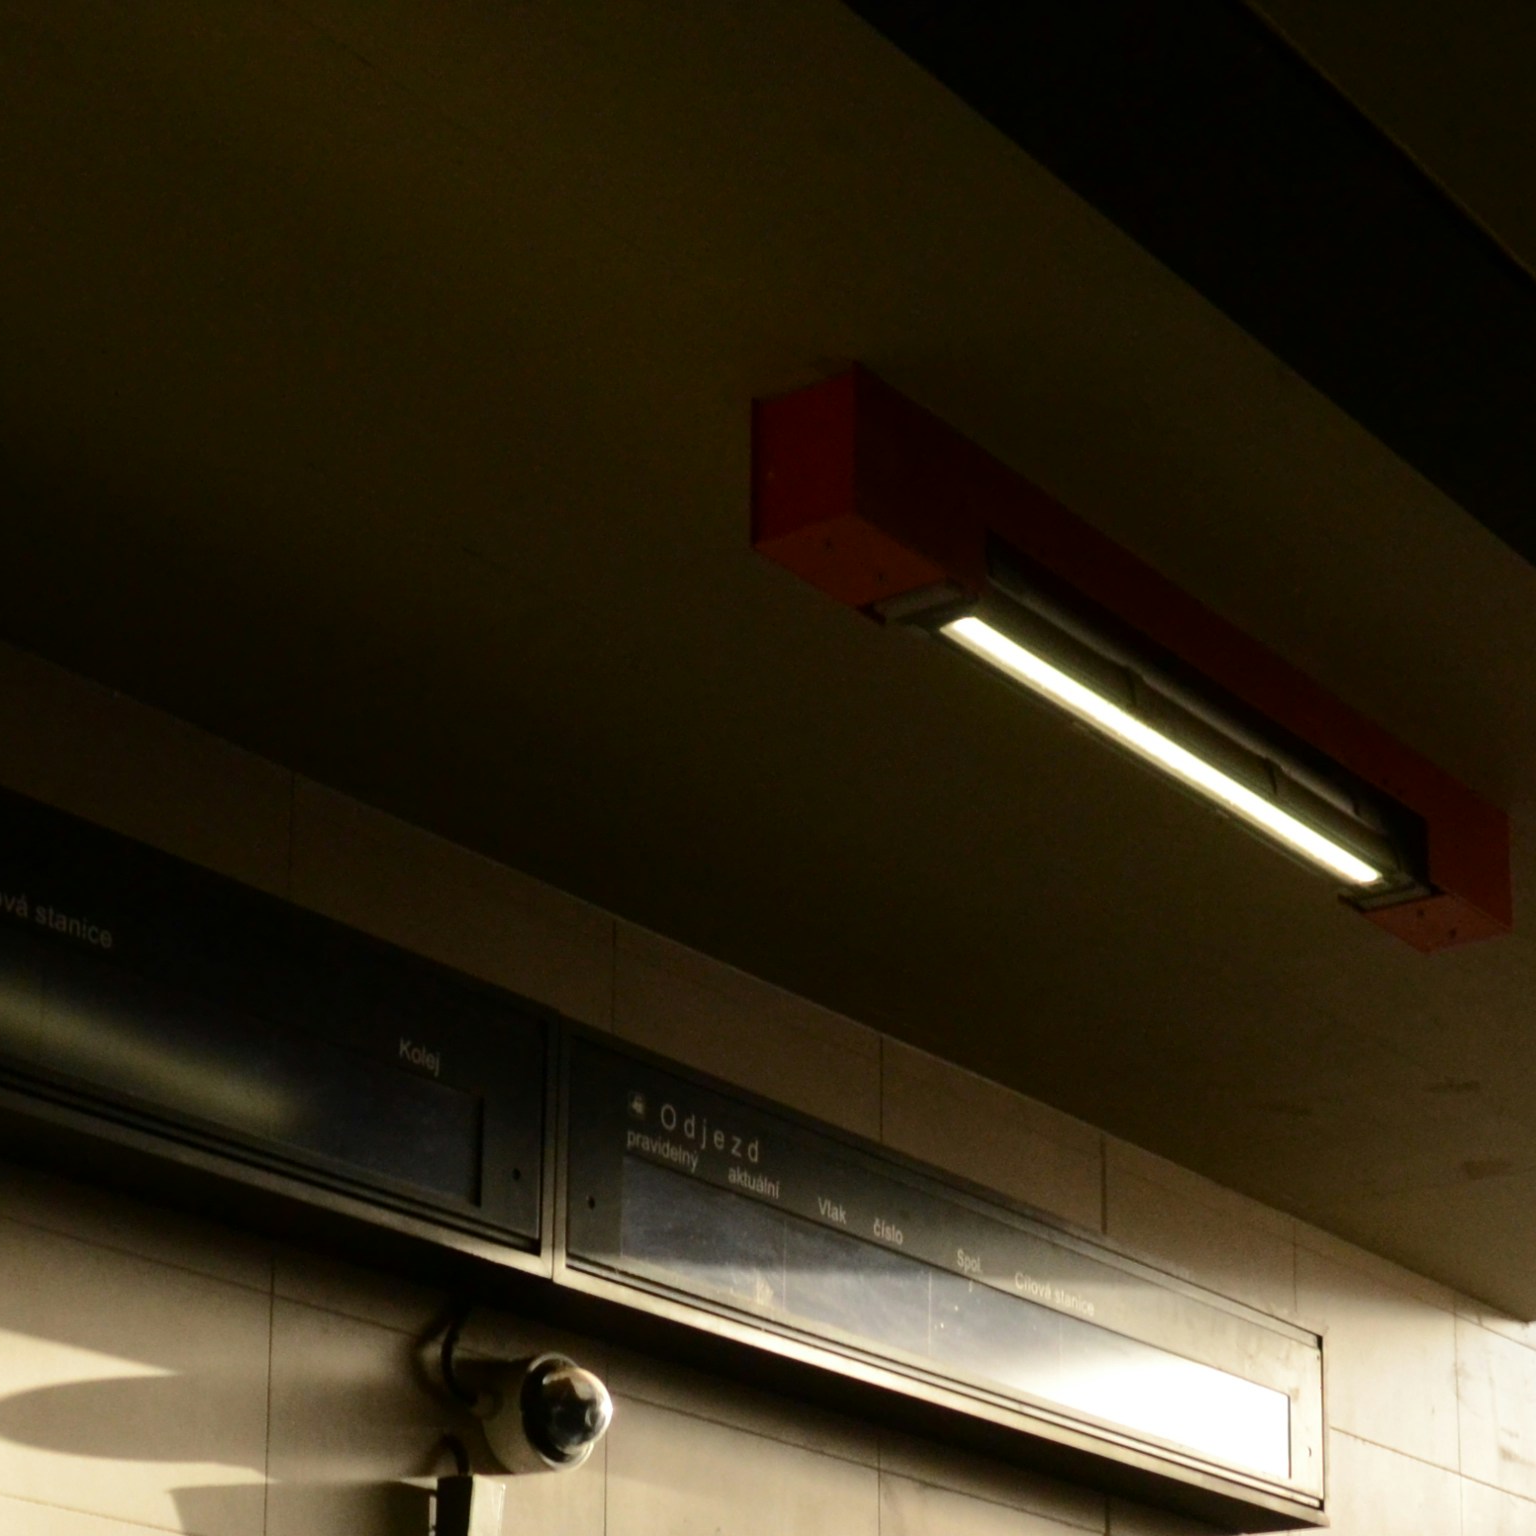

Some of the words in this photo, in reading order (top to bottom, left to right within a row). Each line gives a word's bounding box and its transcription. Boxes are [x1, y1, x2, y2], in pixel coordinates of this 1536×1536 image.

[33, 904, 114, 950] stanice
[398, 1036, 441, 1079] Kolej
[659, 1102, 760, 1164] Odjezd
[626, 1128, 700, 1174] pravidelný
[727, 1165, 781, 1200] aktuální
[817, 1196, 848, 1226] Vlak
[872, 1216, 905, 1246] číslo
[1014, 1272, 1053, 1301] Cílová
[1055, 1289, 1095, 1317] stanice
